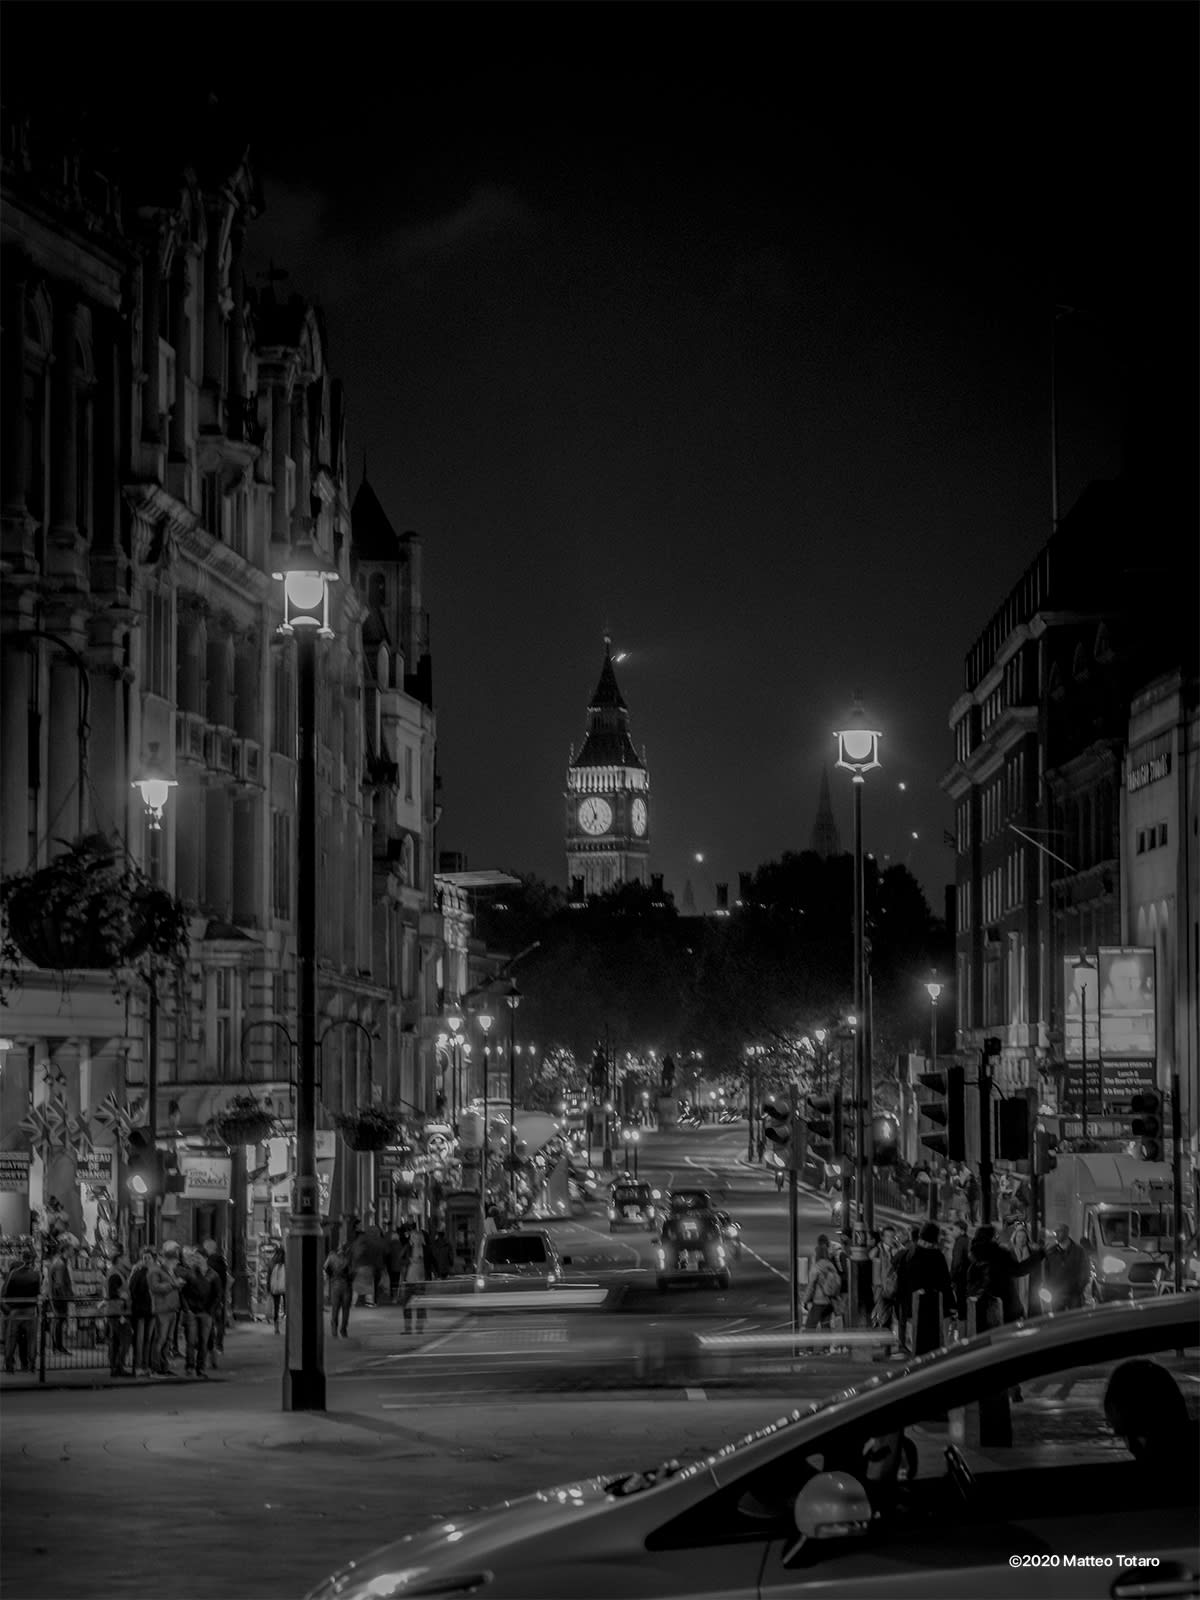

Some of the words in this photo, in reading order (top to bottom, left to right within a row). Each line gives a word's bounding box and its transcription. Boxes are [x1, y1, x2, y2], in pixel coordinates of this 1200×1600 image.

[77, 1153, 111, 1162] BUREAU
[88, 1162, 99, 1170] DE
[76, 1169, 111, 1178] CHANGE
